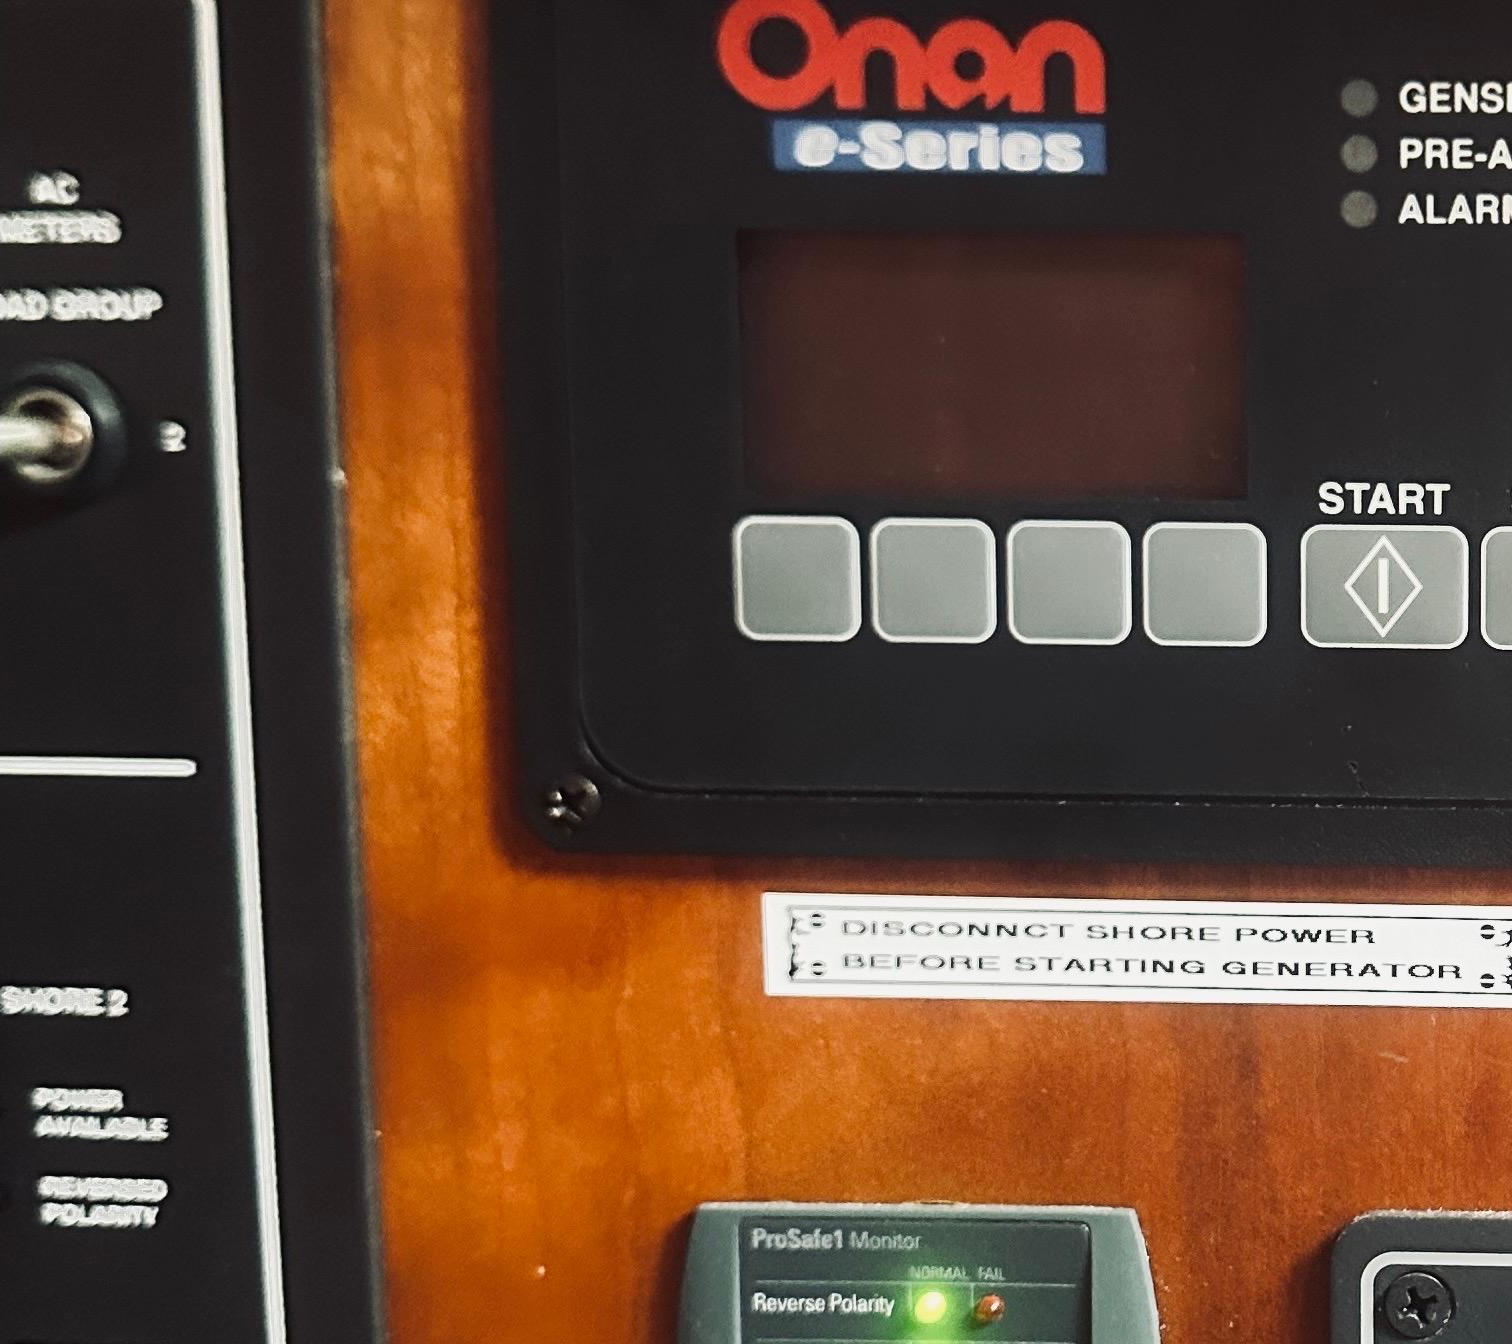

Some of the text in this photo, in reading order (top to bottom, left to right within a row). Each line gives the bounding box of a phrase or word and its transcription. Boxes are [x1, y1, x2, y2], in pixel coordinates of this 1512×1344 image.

[793, 122, 1085, 172] e-Series
[28, 171, 80, 205] AC
[49, 288, 163, 321] GROUP
[1318, 483, 1450, 515] START
[842, 919, 1376, 945] DISCONNCT SHORE POWER
[842, 953, 1462, 980] BEFORE STARTING GENERATOR
[0, 985, 129, 1017] SHORE 2
[29, 1087, 123, 1111] POWER
[34, 1116, 169, 1141] AVAILABLE
[36, 1175, 168, 1202] REVERSED
[38, 1203, 159, 1228] POLARITY
[751, 1228, 921, 1250] ProSafe1 Monitor
[978, 1268, 1006, 1281] FAIL
[752, 1294, 895, 1316] Reverse Polarity
